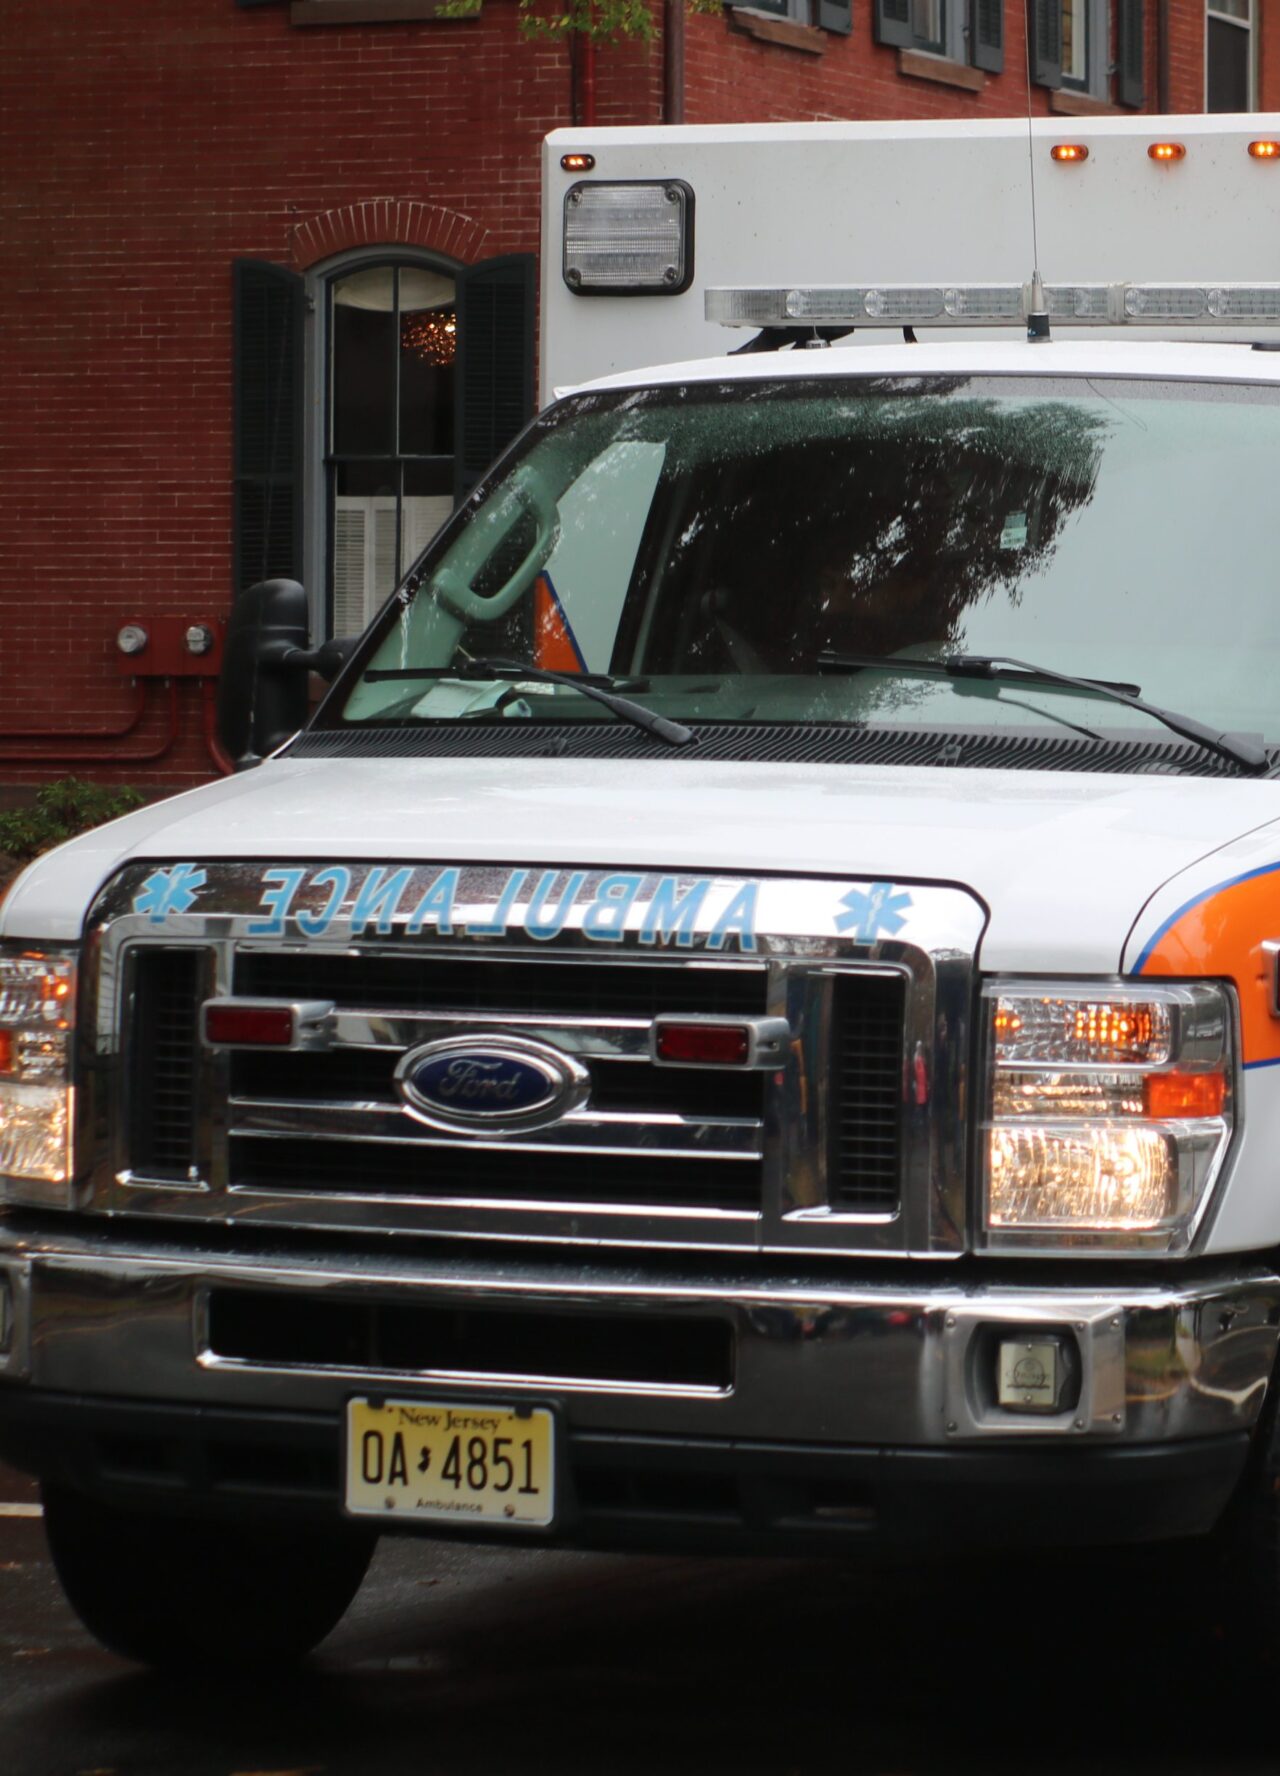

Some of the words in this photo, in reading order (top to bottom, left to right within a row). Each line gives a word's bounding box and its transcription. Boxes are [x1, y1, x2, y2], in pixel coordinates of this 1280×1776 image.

[438, 1058, 523, 1099] Ford
[398, 1408, 441, 1426] New
[443, 1410, 501, 1434] Jersey
[441, 1434, 540, 1495] 4851
[416, 1497, 484, 1514] Ambulance
